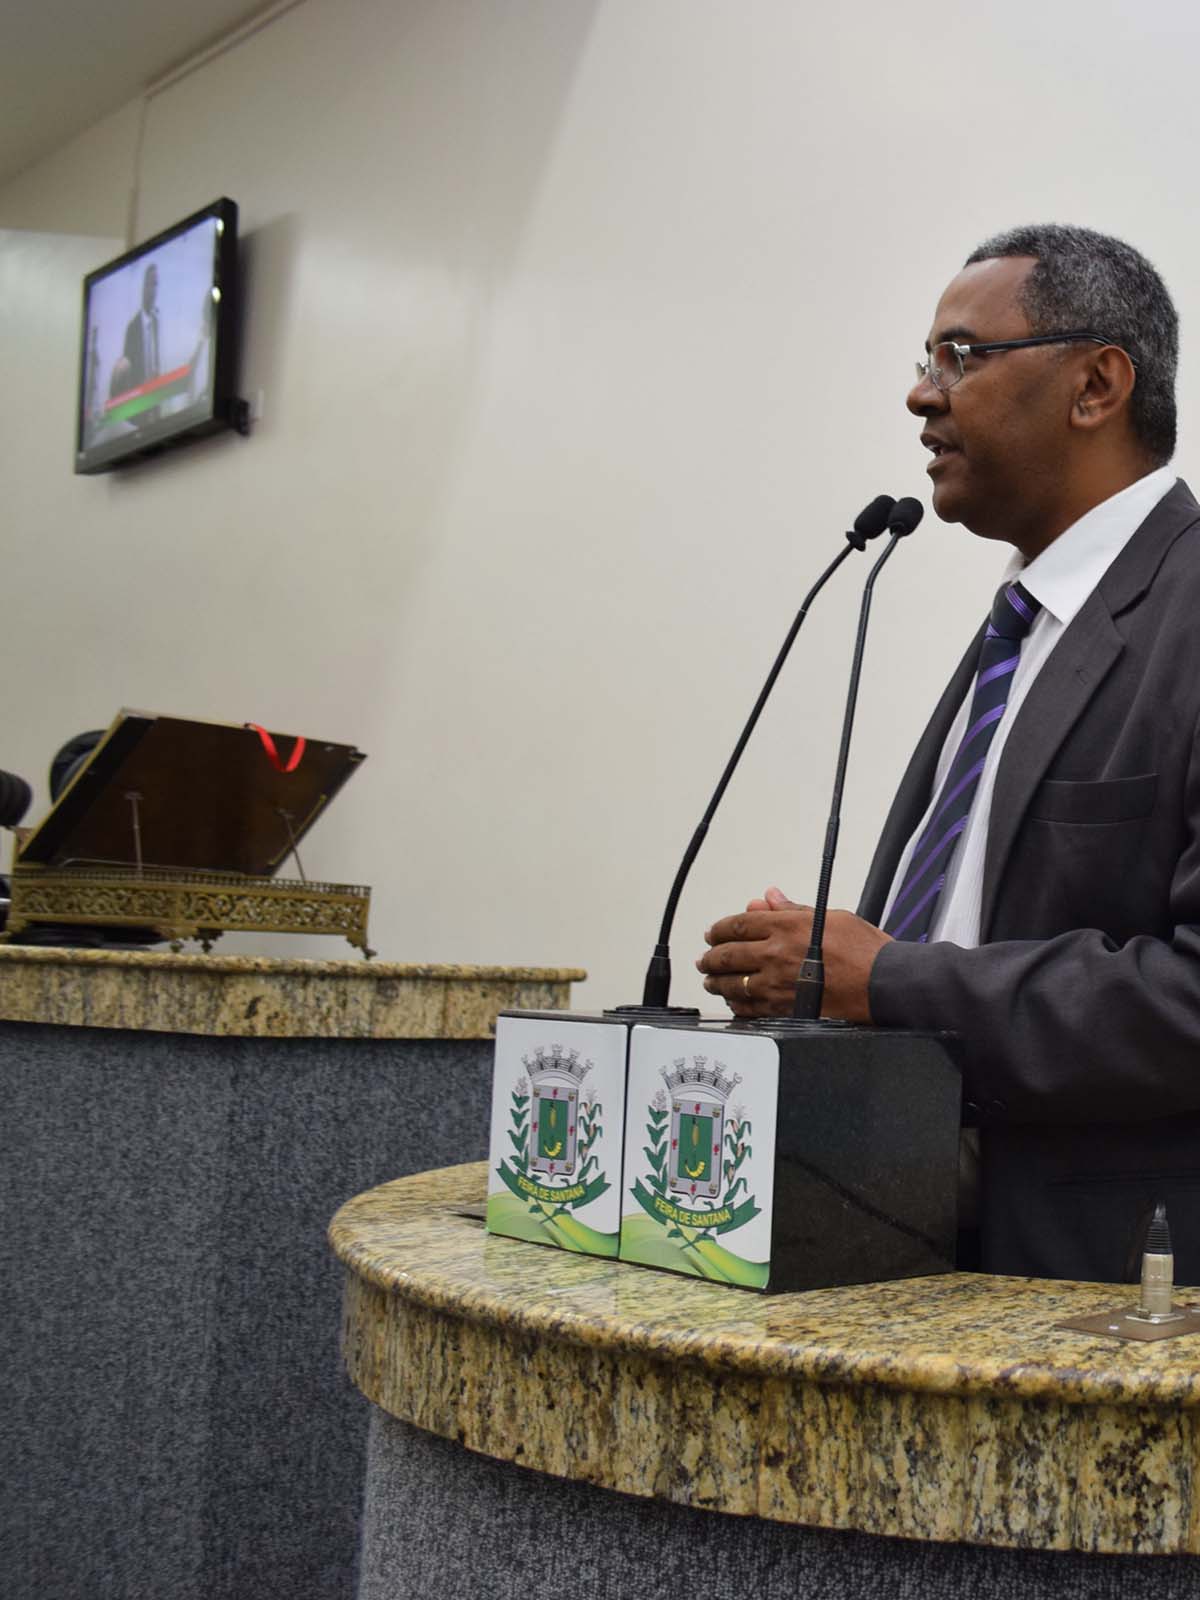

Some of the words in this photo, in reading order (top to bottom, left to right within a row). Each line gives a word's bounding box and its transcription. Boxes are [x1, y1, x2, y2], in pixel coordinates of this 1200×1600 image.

[518, 1176, 538, 1195] FEIRA
[540, 1188, 550, 1200] DE
[552, 1185, 585, 1201] SANTANA
[655, 1197, 678, 1219] FEIRA
[680, 1210, 690, 1224] DE
[692, 1208, 732, 1226] SANTANA
